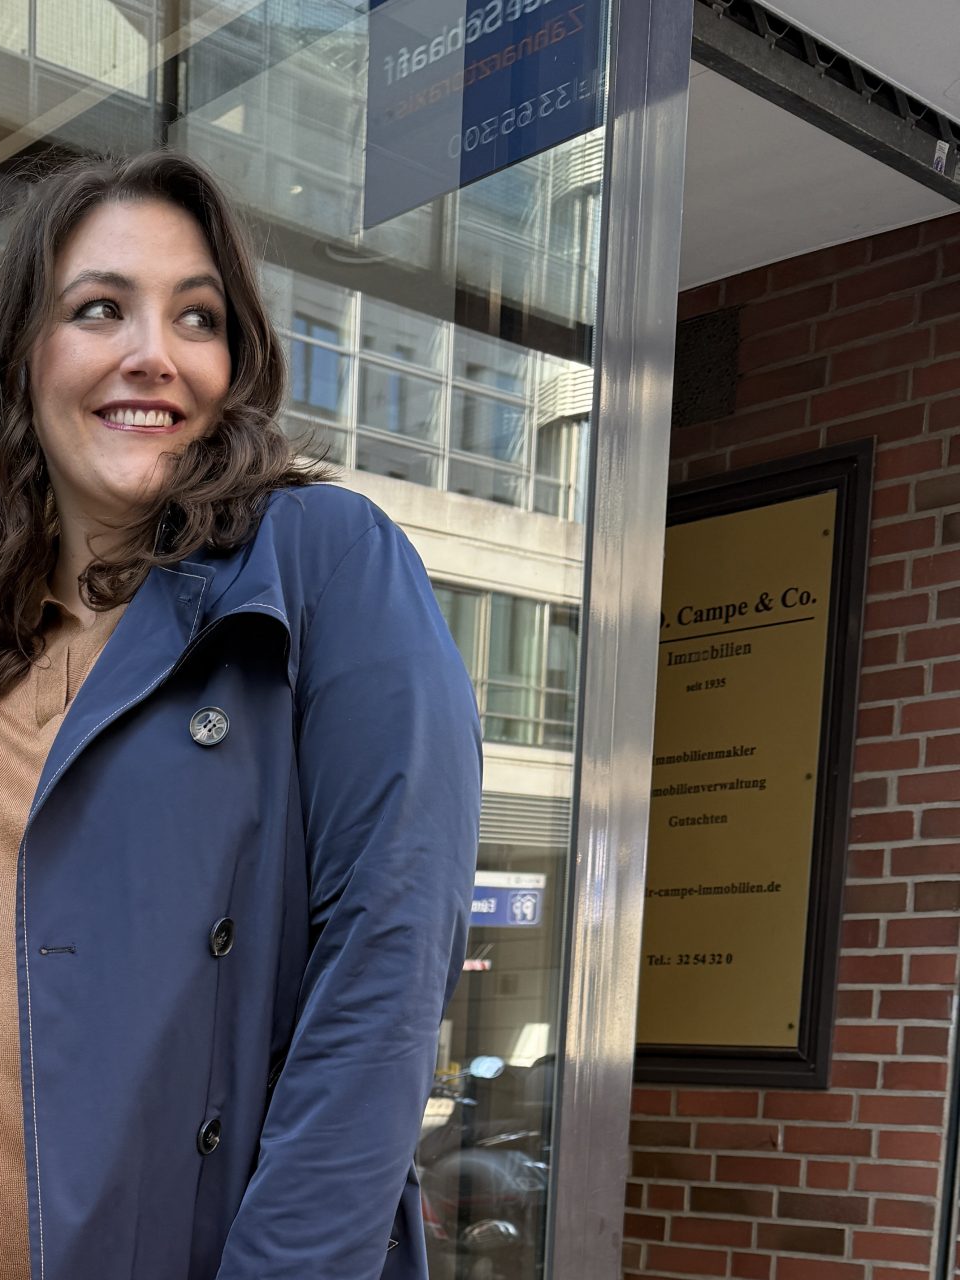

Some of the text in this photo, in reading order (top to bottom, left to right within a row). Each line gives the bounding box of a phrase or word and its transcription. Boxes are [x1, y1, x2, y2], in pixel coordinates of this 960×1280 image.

[677, 599, 748, 627] Campe
[754, 591, 773, 613] &
[780, 586, 818, 609] Co.
[666, 642, 752, 667] Immobilien
[686, 677, 727, 692] seit 1935
[651, 777, 767, 798] mobilienverwaltung
[668, 813, 728, 828] Gutachten
[676, 954, 691, 966] 32
[692, 954, 707, 966] 54
[708, 953, 723, 965] 32
